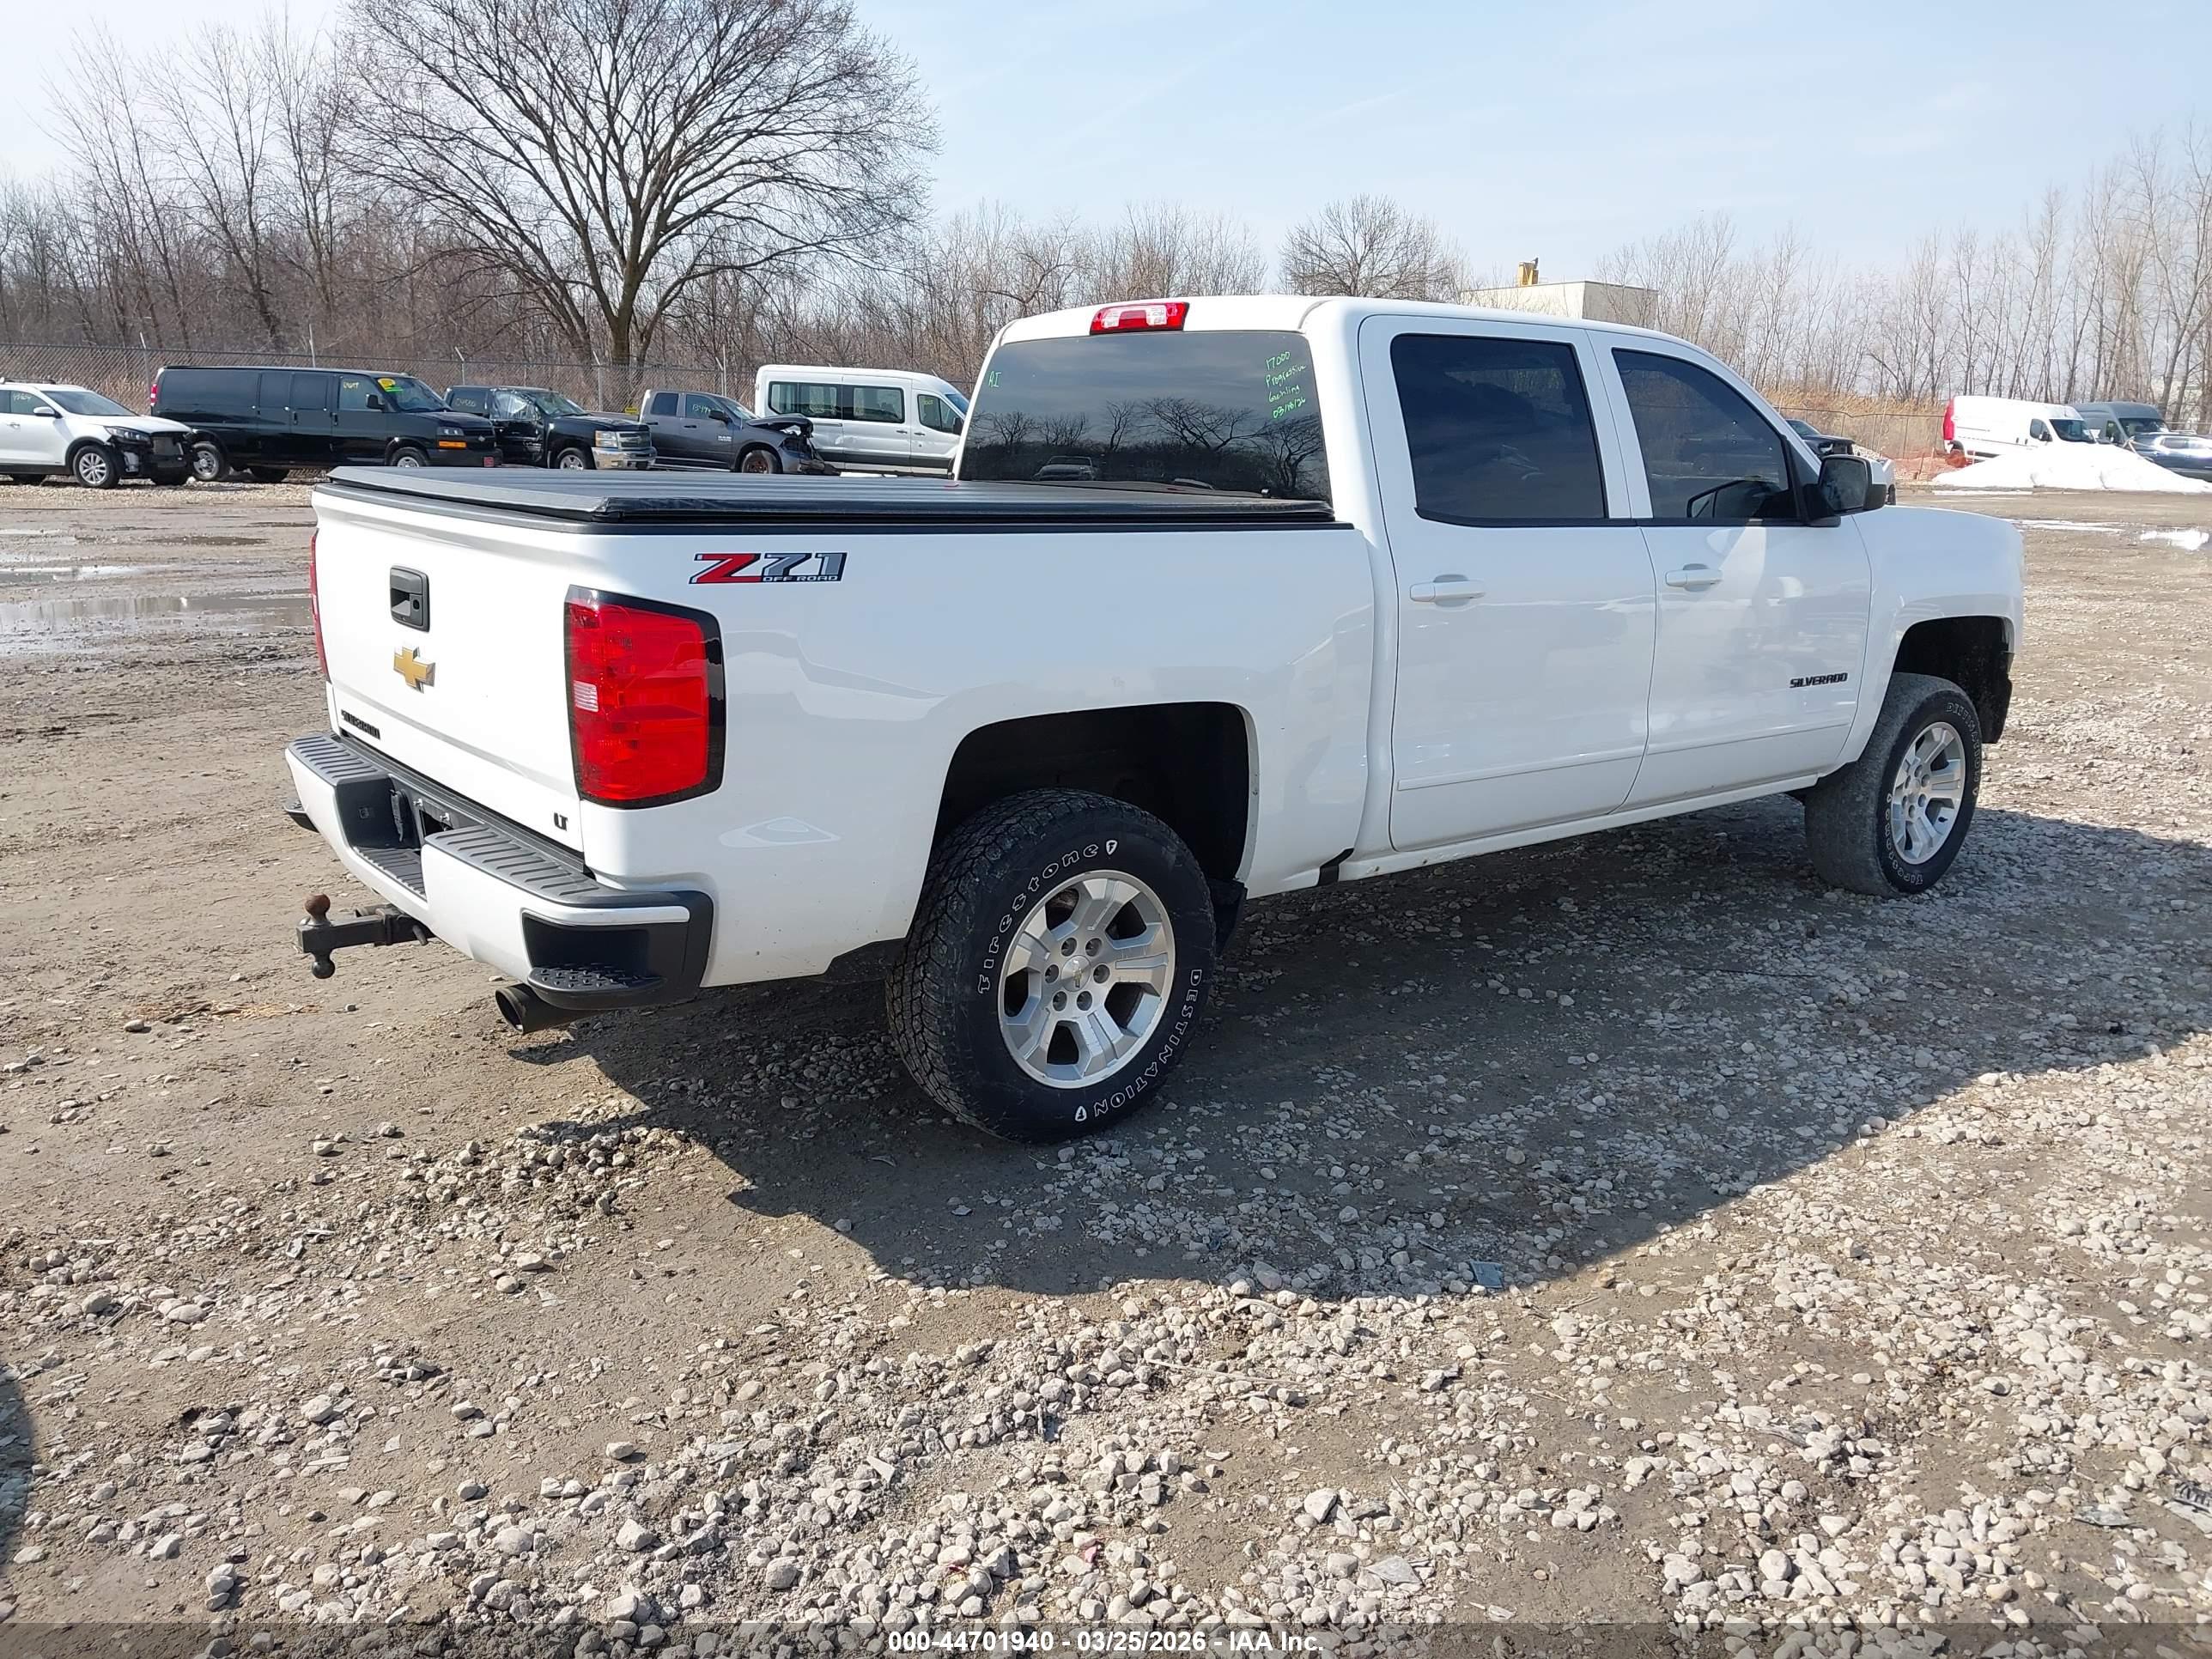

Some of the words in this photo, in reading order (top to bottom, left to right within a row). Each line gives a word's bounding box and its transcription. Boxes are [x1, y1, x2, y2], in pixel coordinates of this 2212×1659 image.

[689, 552, 848, 585] Z71
[1789, 672, 1848, 689] SILVERADO
[554, 812, 568, 831] LT
[1094, 969, 1202, 1117] DESTINATION
